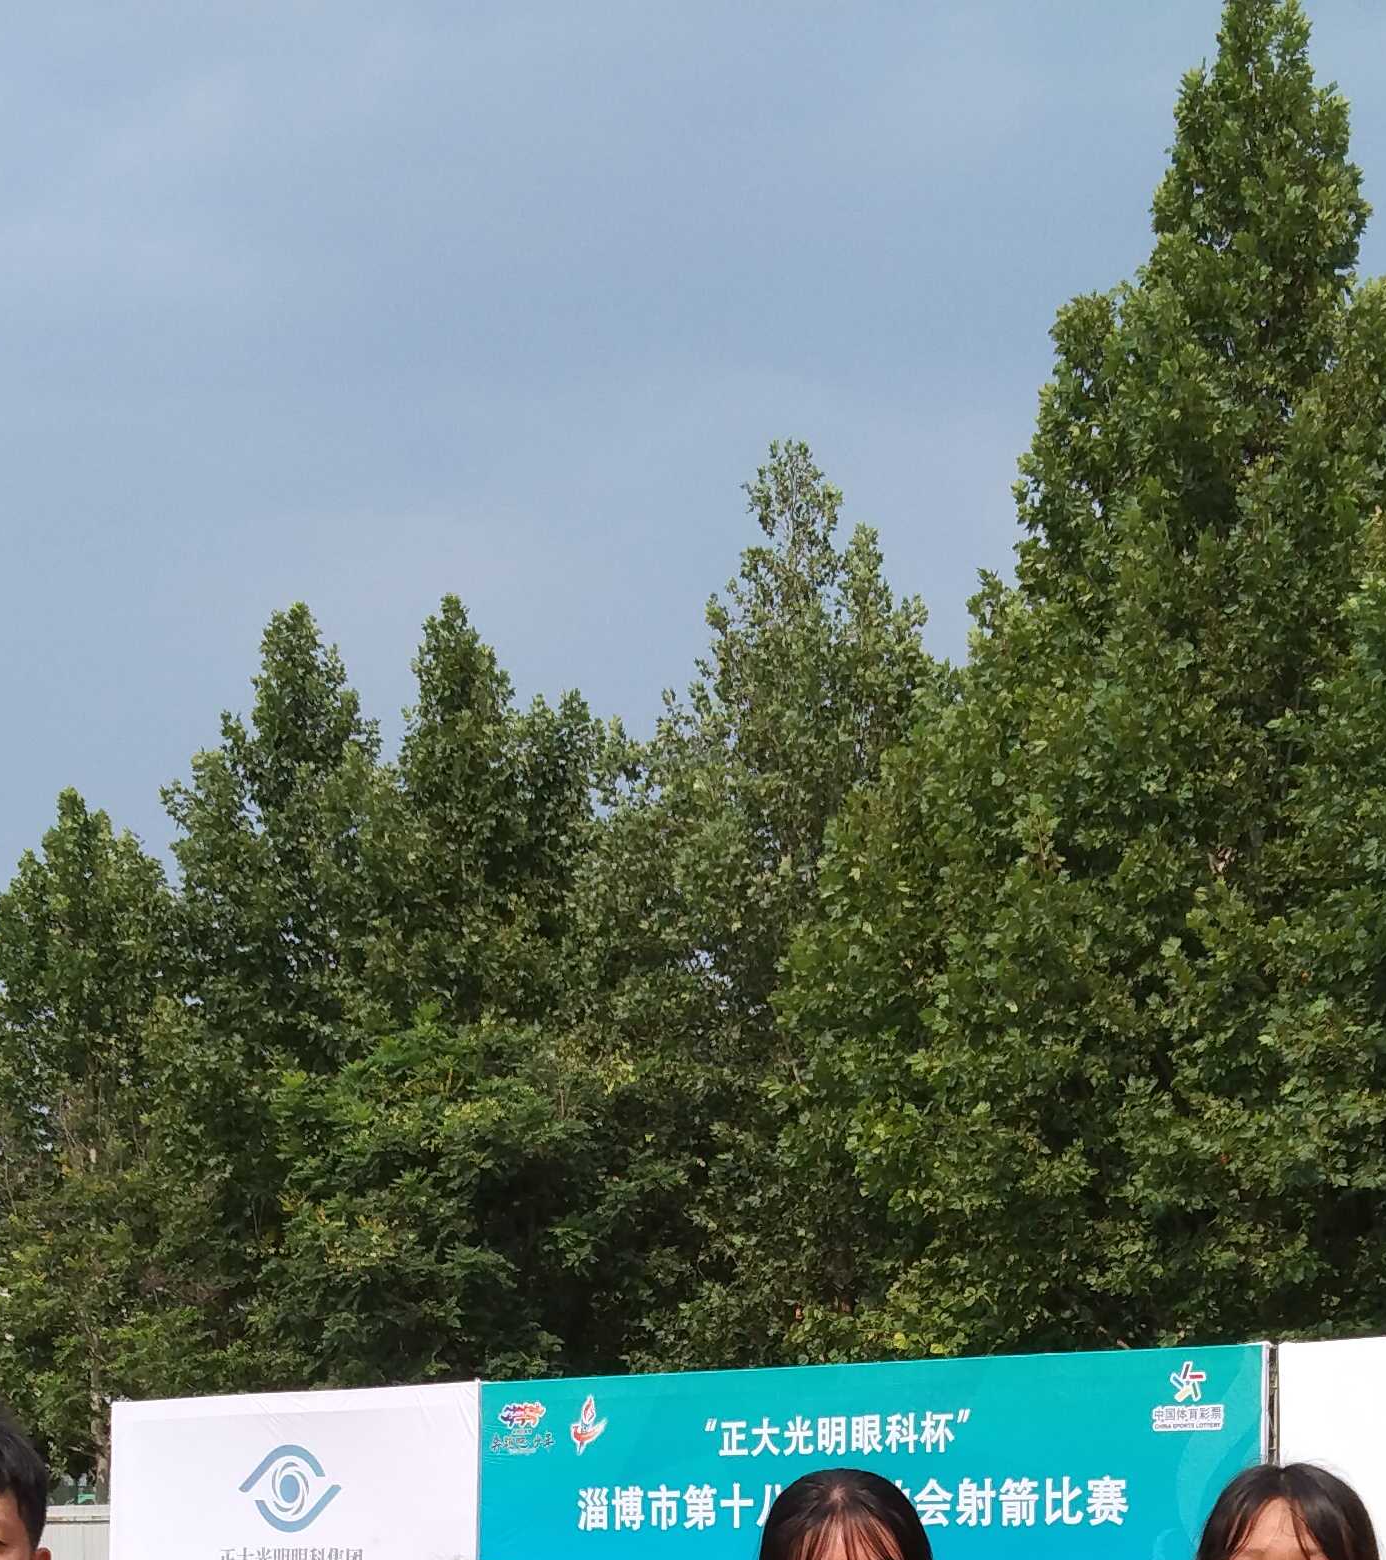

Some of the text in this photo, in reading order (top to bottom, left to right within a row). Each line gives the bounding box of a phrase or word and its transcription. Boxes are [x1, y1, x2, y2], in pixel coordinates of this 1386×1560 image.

[577, 1475, 1130, 1531] 淄博市第十八会射箭比赛
